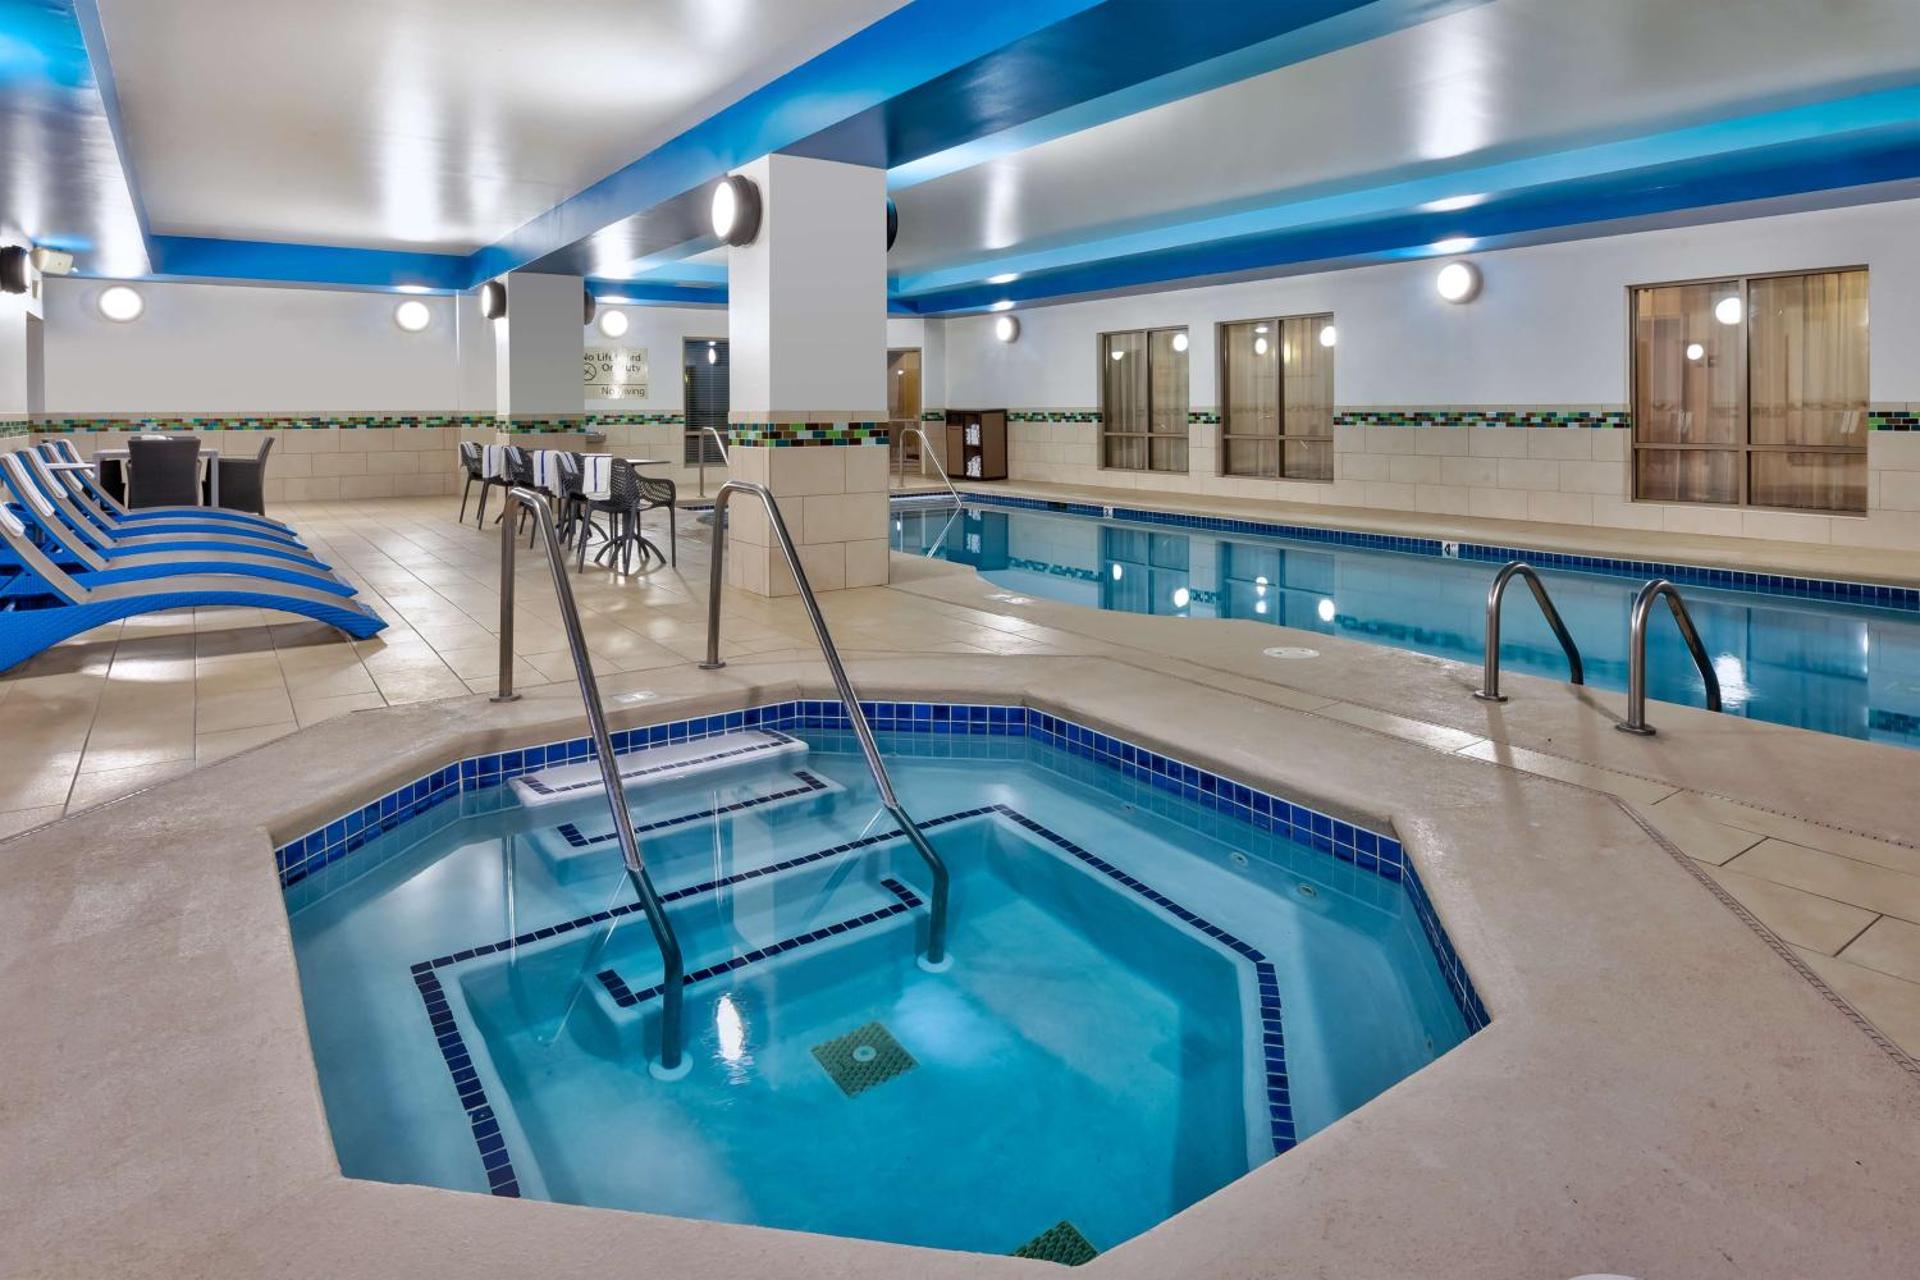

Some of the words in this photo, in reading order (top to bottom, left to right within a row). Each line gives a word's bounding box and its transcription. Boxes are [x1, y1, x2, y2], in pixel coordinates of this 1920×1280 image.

[597, 352, 641, 362] Lifrd
[619, 364, 641, 373] uty
[618, 387, 645, 398] ving
[1444, 543, 1451, 556] 4
